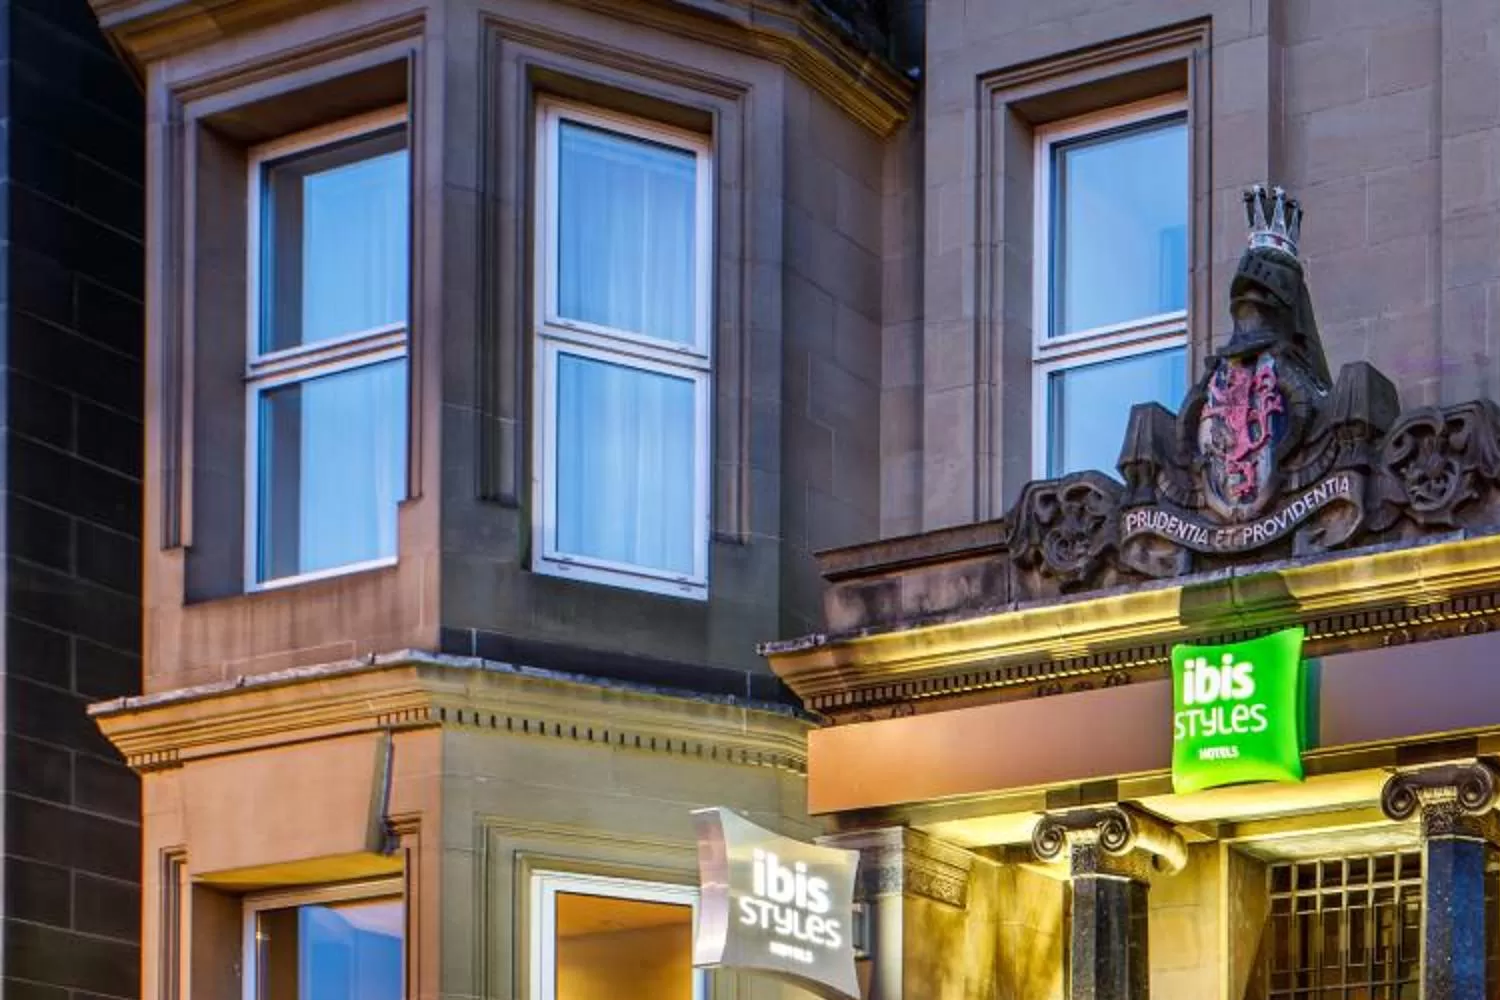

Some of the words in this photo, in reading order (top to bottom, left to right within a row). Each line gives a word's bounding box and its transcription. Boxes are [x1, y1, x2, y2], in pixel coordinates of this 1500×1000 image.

[1124, 509, 1209, 546] PRUDENTIA
[1242, 475, 1350, 545] PROVIDENTIA
[1183, 653, 1256, 705] ibis
[1199, 745, 1240, 761] HOTELS
[752, 847, 831, 914] ibis
